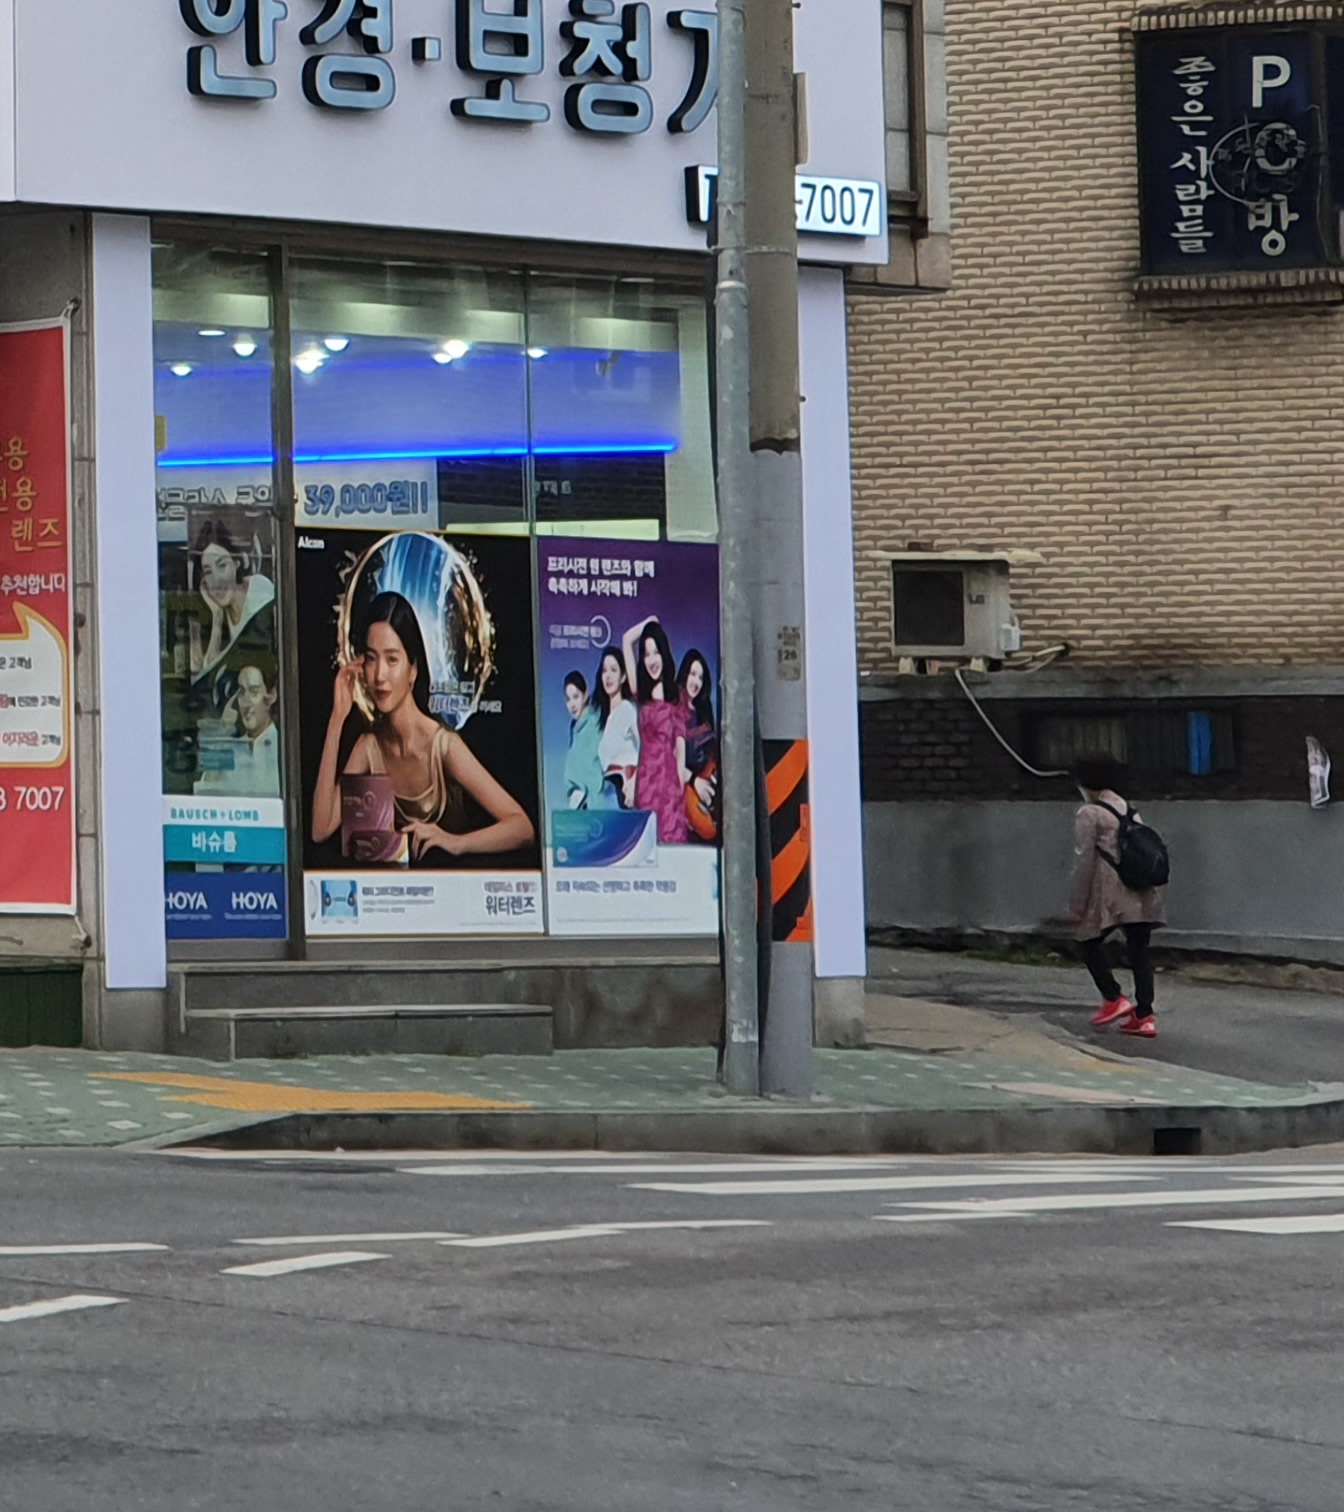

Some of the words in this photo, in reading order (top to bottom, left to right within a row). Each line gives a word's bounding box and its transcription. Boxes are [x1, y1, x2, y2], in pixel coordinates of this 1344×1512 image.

[11, 518, 63, 552] 렌즈
[14, 785, 65, 811] 7007
[170, 807, 218, 820] BAUSCH
[229, 809, 260, 822] LOMB
[231, 891, 278, 910] HOYA
[485, 895, 536, 916] 워터렌즈
